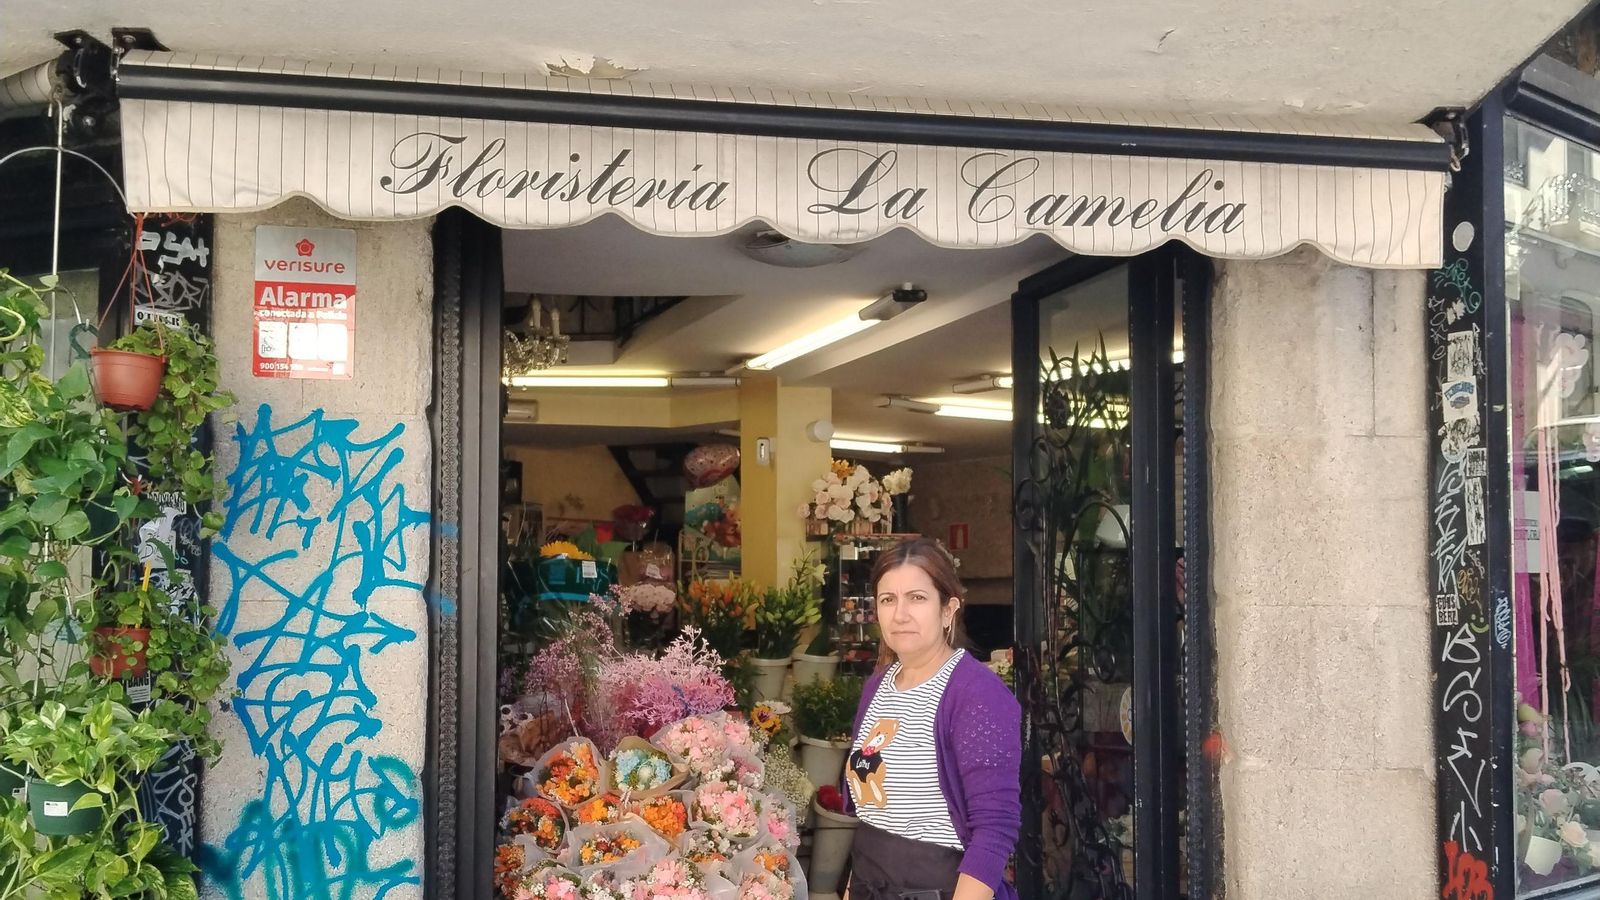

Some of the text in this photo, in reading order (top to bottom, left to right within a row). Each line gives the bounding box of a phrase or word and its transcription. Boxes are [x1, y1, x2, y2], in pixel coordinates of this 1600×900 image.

[807, 147, 928, 219] La
[961, 152, 1247, 234] Camelia
[264, 259, 346, 274] verisure
[260, 286, 347, 309] Alarma
